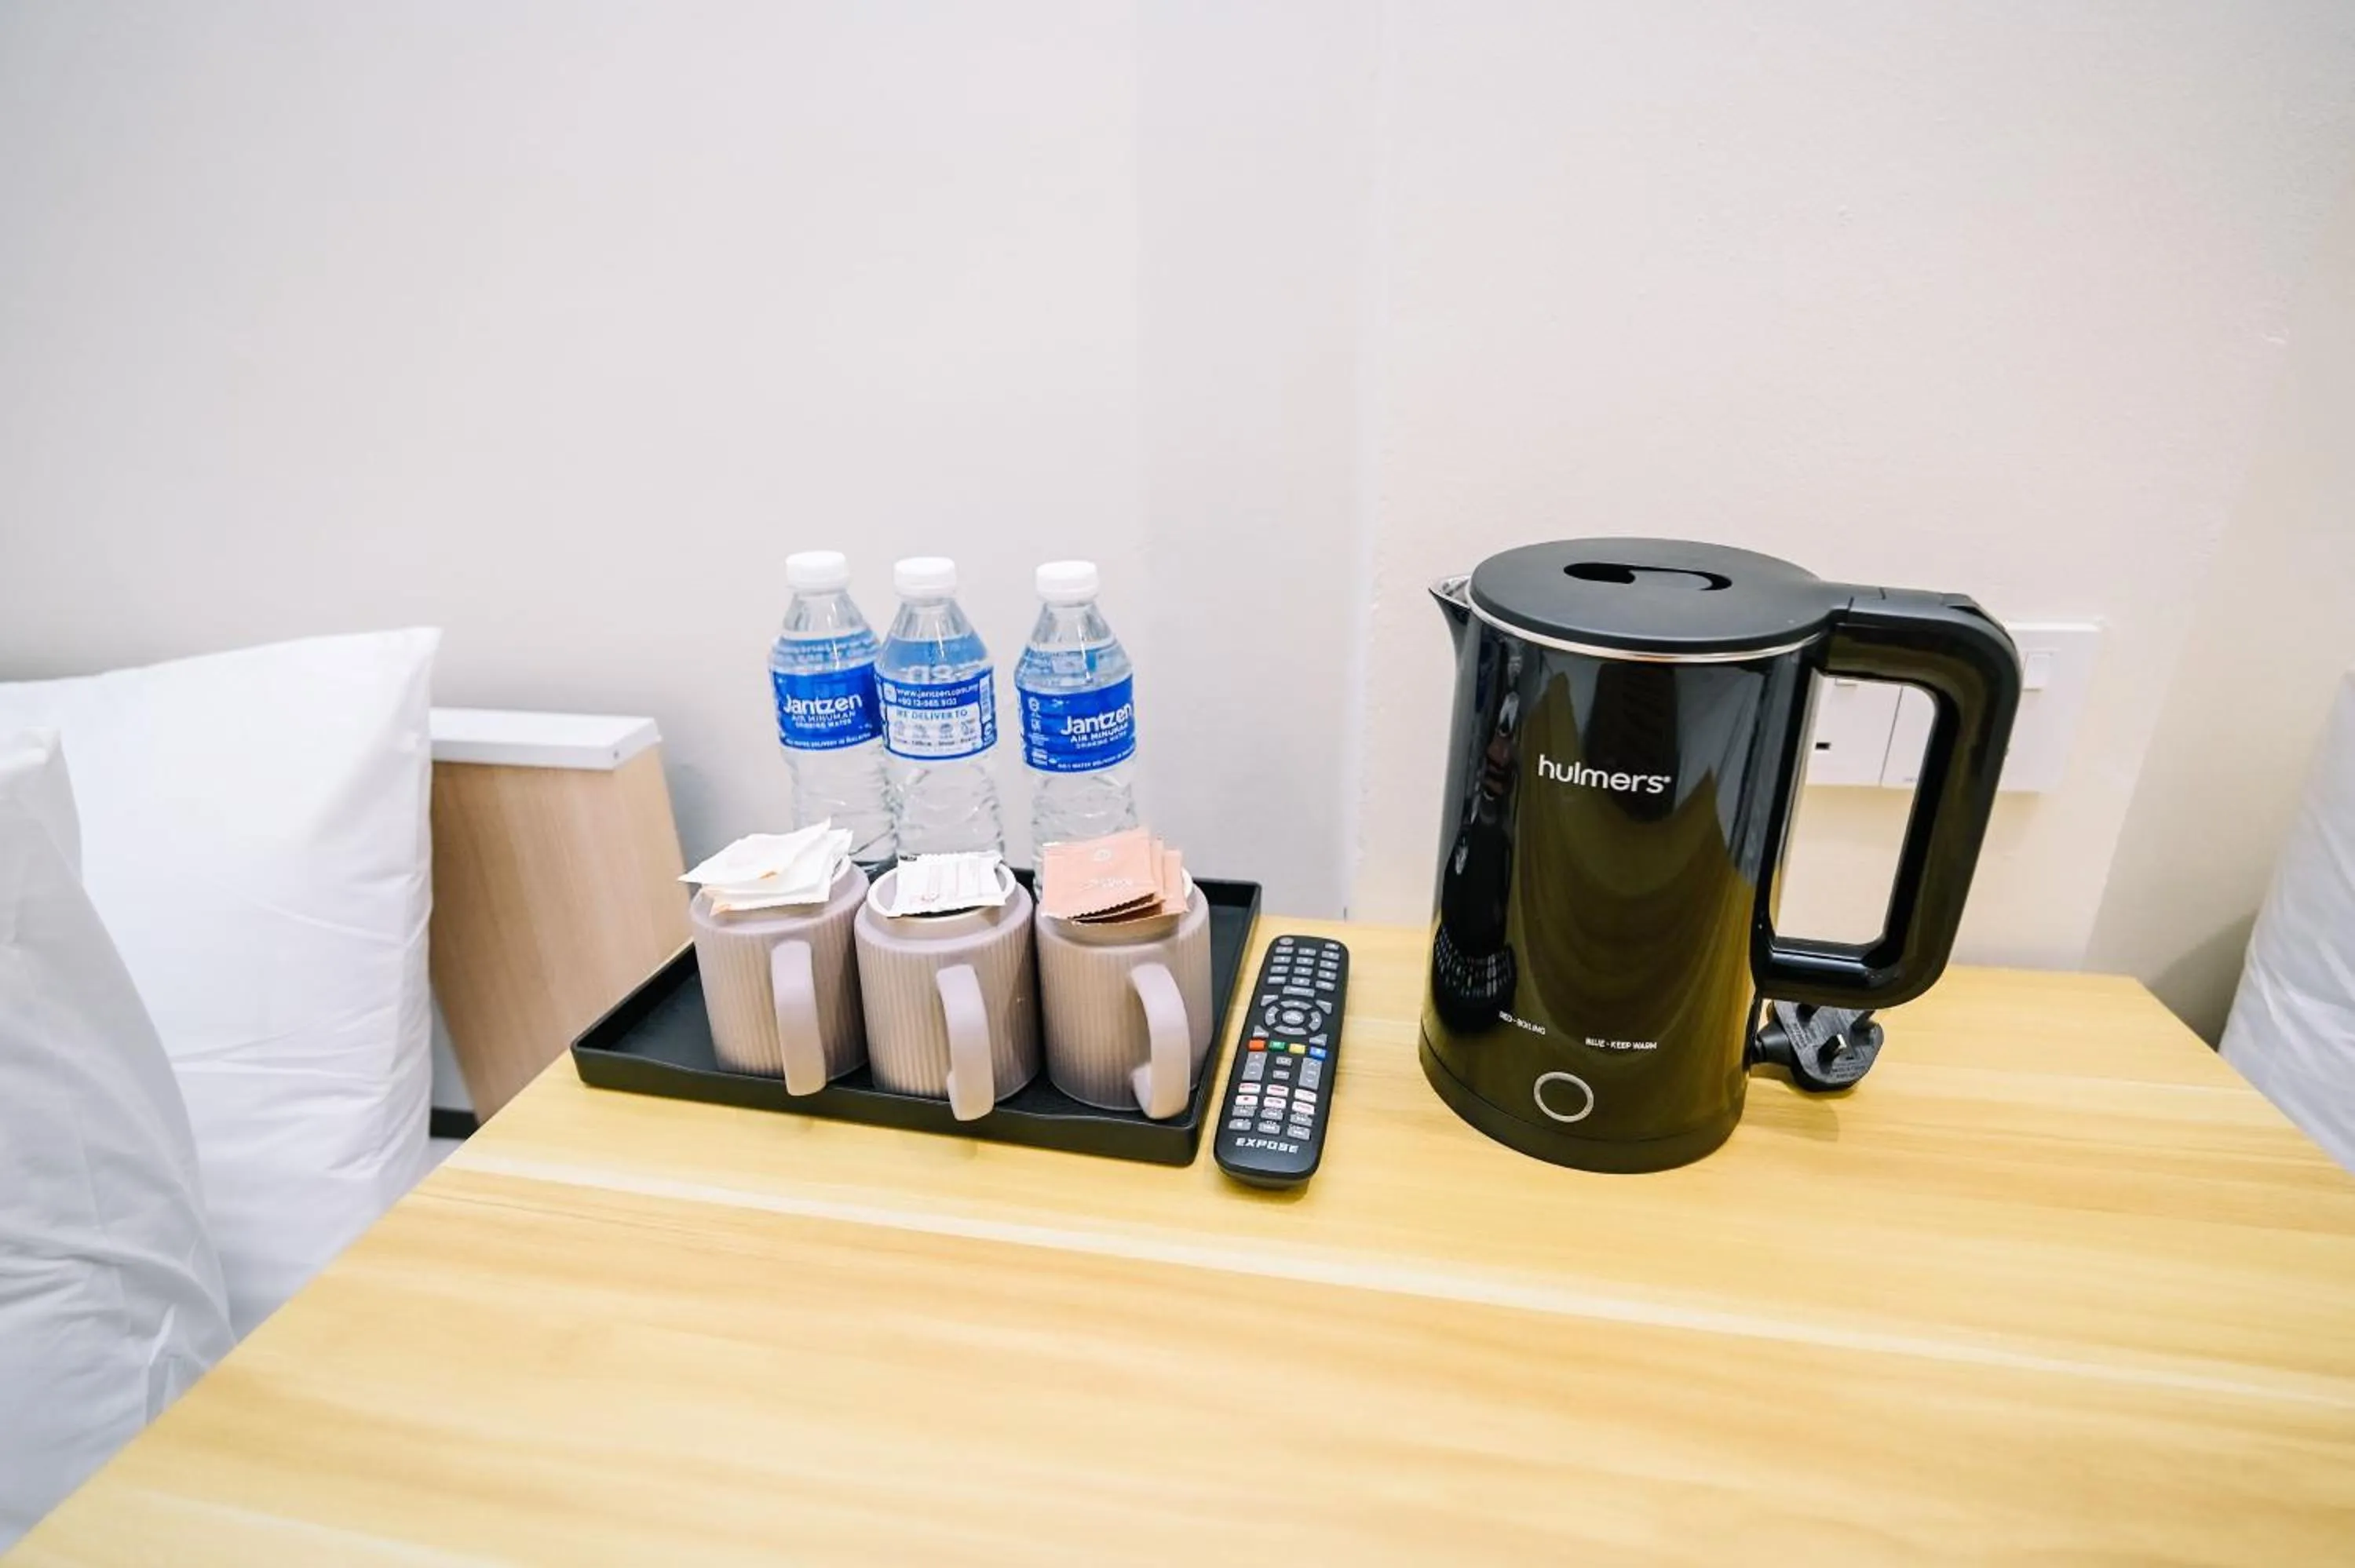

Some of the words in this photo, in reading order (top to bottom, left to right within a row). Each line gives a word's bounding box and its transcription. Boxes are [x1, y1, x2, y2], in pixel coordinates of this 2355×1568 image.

[783, 694, 863, 715] Jantzen
[1061, 703, 1132, 735] Jantzen
[1611, 1041, 1632, 1049] KEEP
